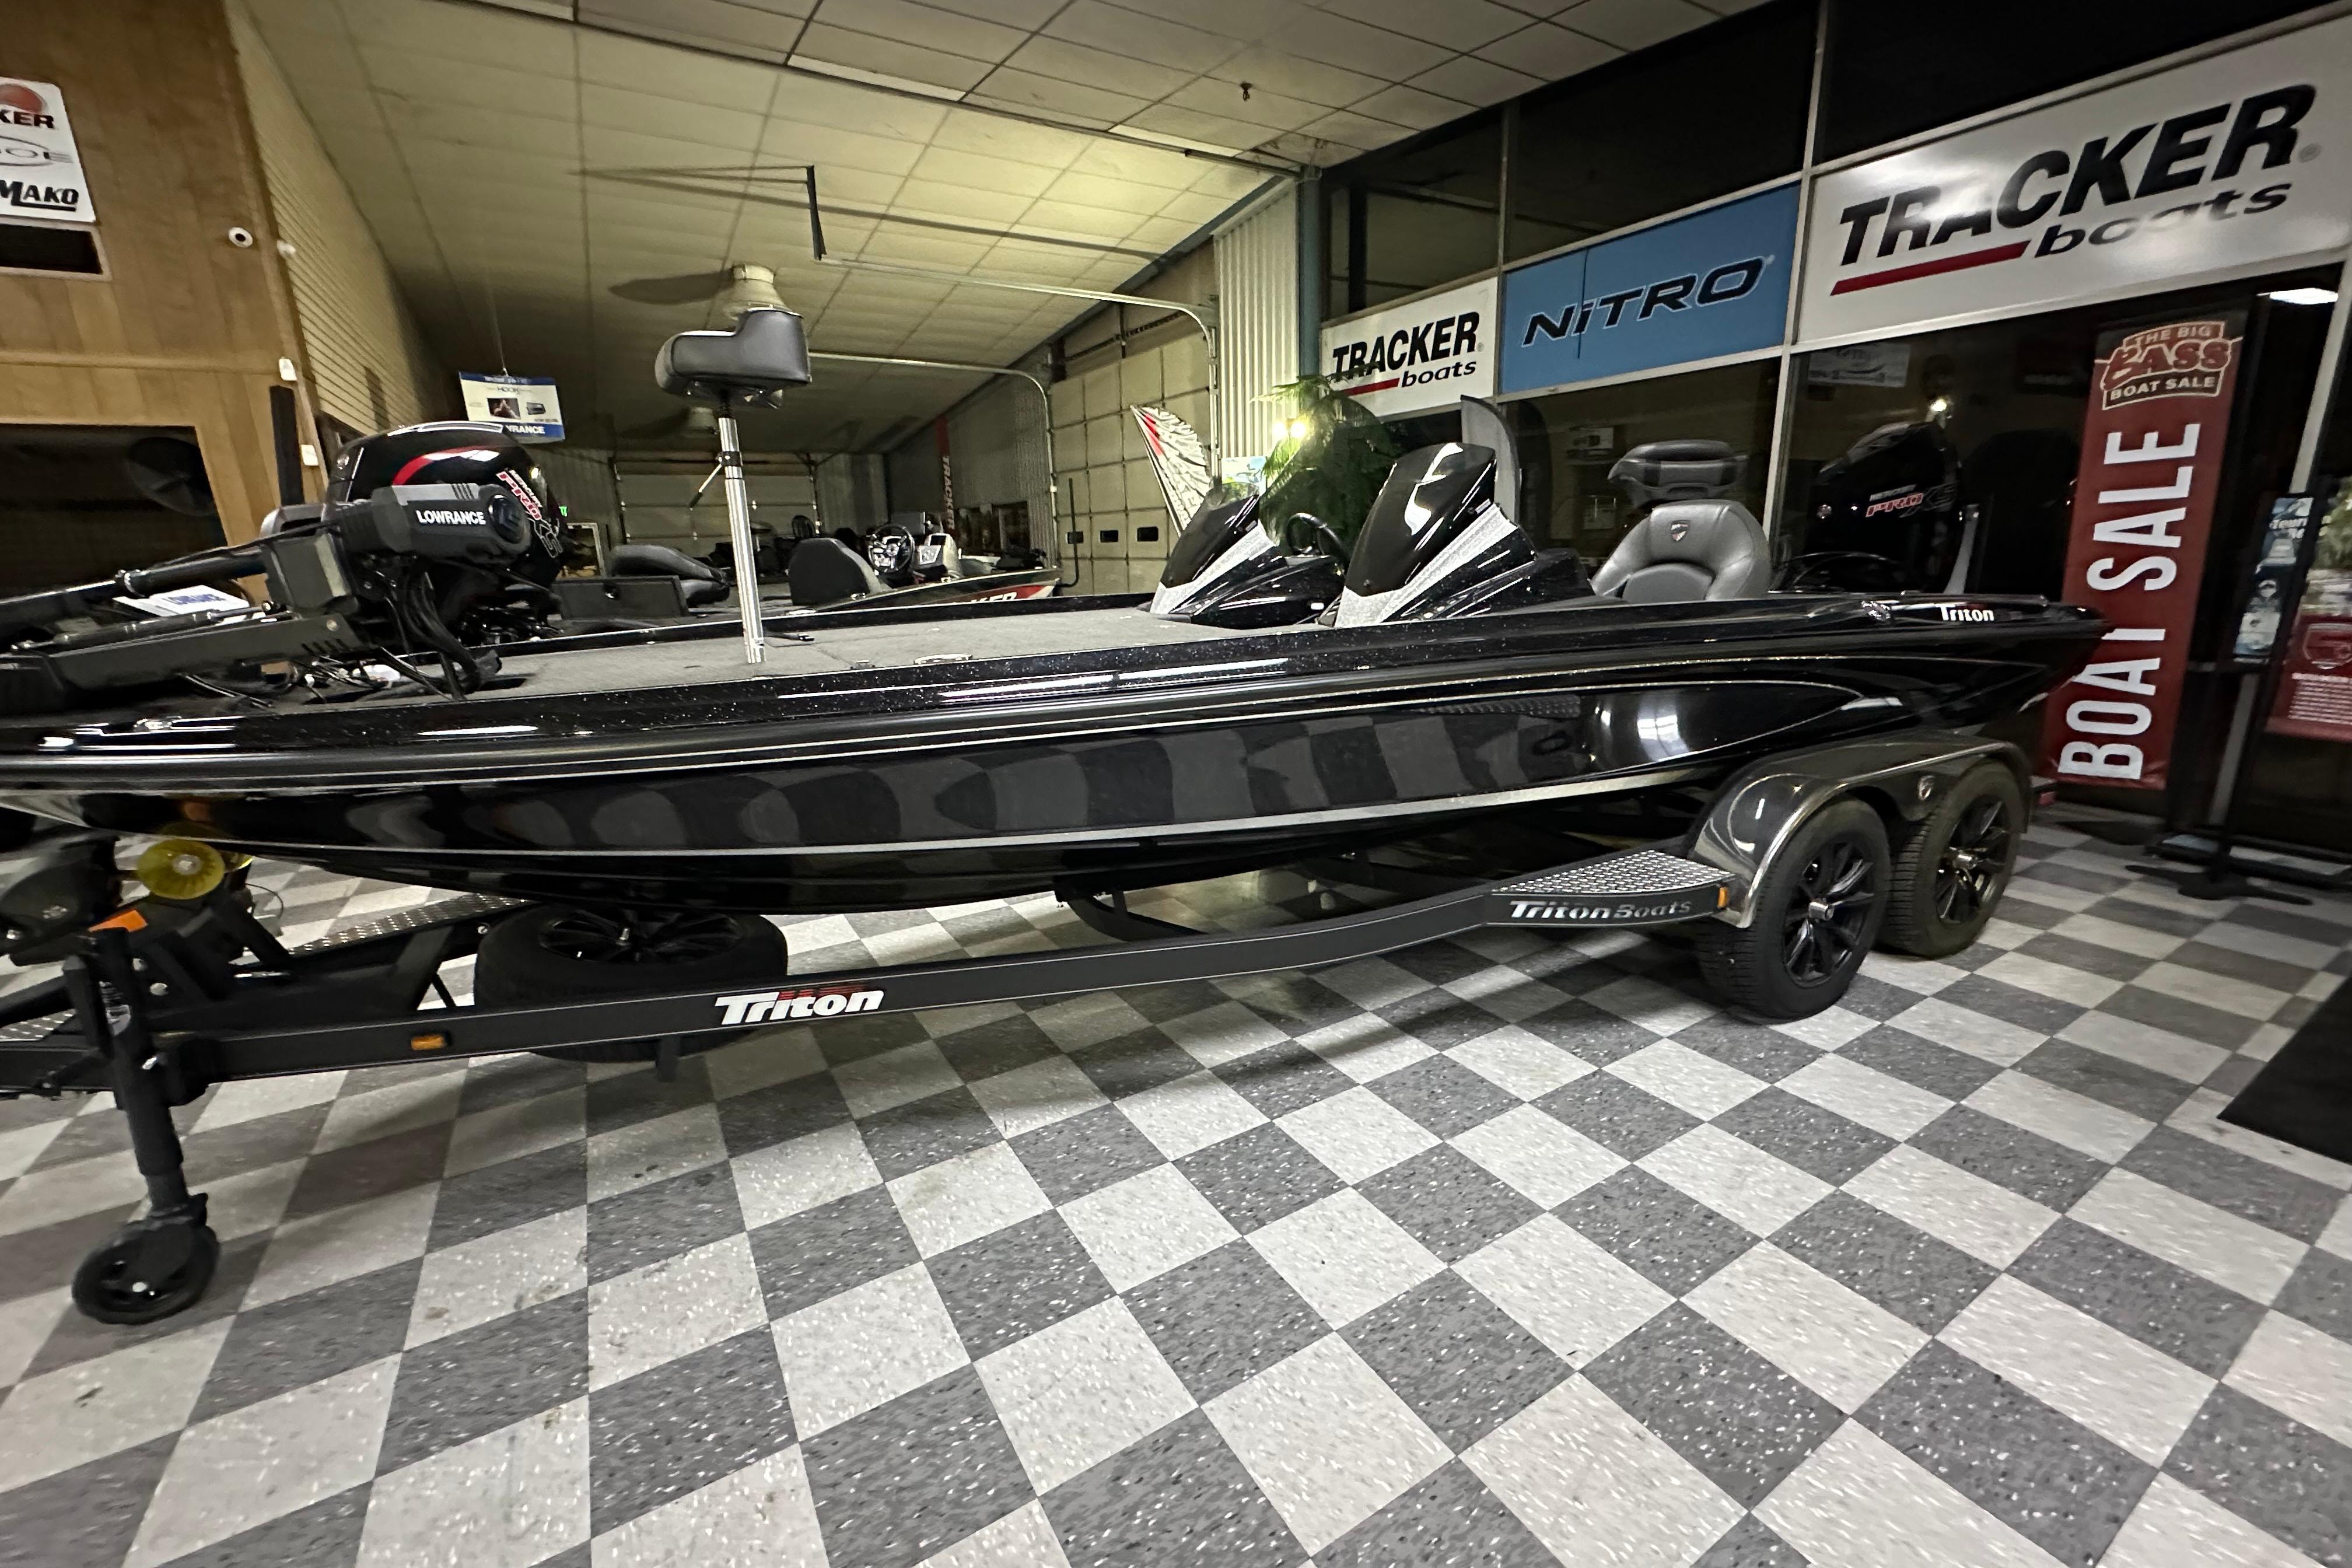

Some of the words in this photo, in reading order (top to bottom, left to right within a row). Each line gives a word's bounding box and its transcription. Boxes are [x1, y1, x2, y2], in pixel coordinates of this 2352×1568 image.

[1840, 83, 2316, 266] TRACKER
[0, 179, 79, 212] MAKO
[1332, 312, 1480, 382] TRACKER
[2134, 329, 2171, 345] THE
[2177, 326, 2213, 339] BIG
[1401, 360, 1477, 388] boats
[2100, 337, 2232, 391] BASS
[2110, 380, 2161, 401] BOAT
[2165, 376, 2216, 390] SALE
[415, 510, 487, 525] LOWRANCE
[2086, 424, 2201, 591] SALE
[1936, 603, 1994, 622] Triton
[1510, 900, 1611, 920] Triton
[1614, 901, 1692, 919] Boats
[715, 989, 885, 1025] Triton
